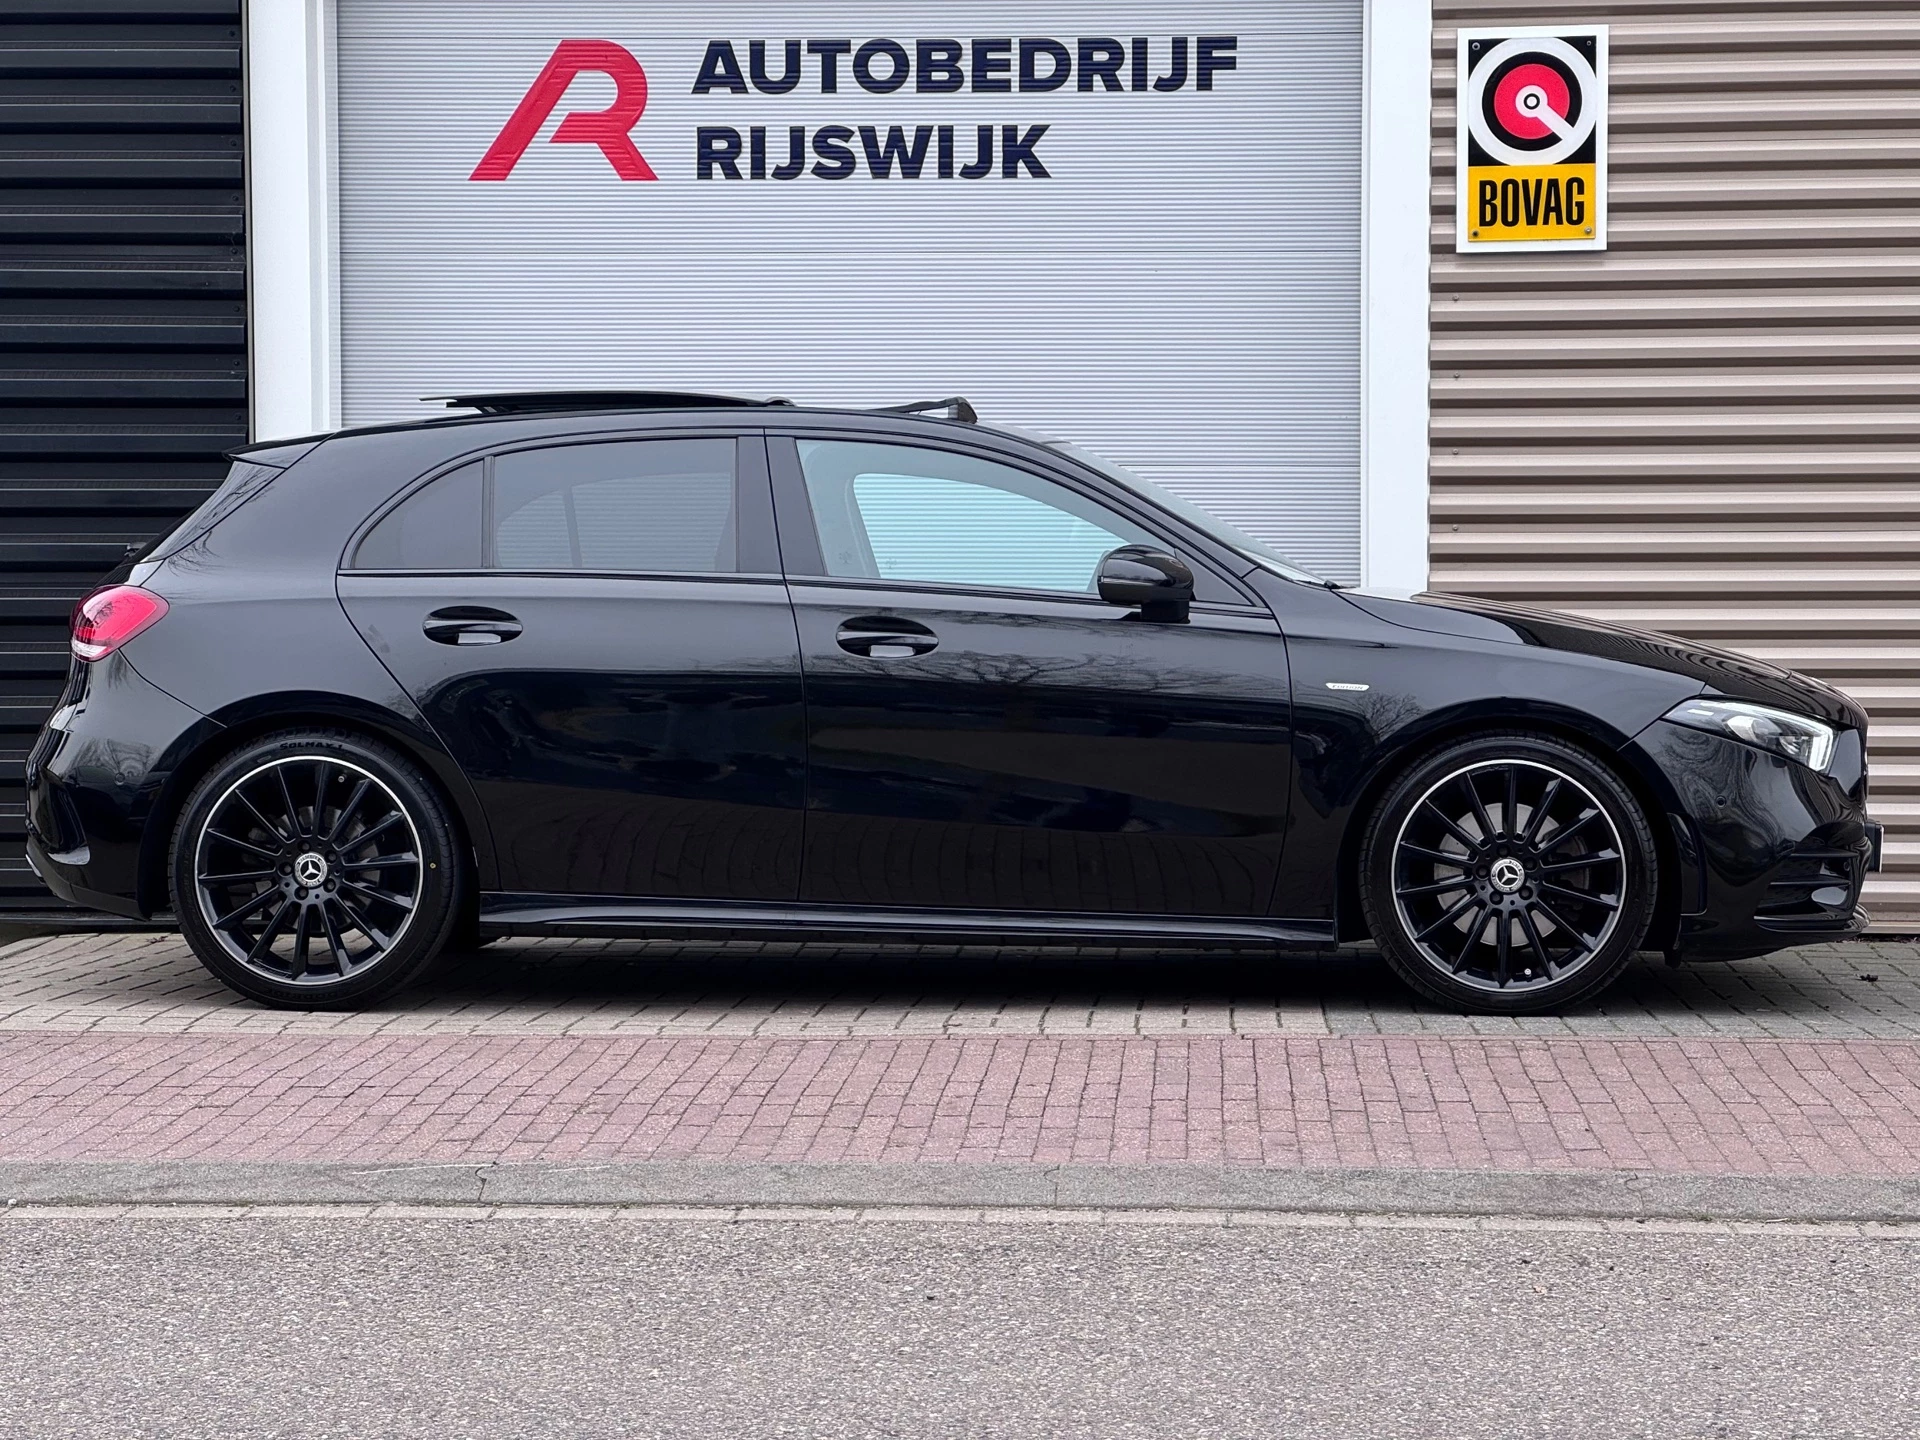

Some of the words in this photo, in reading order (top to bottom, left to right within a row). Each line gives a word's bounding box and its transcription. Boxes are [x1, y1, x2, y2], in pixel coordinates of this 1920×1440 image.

[691, 36, 1238, 94] AUTOBEDRIJF
[697, 125, 1052, 180] RIJSWIJK
[1479, 177, 1585, 227] BOVAG
